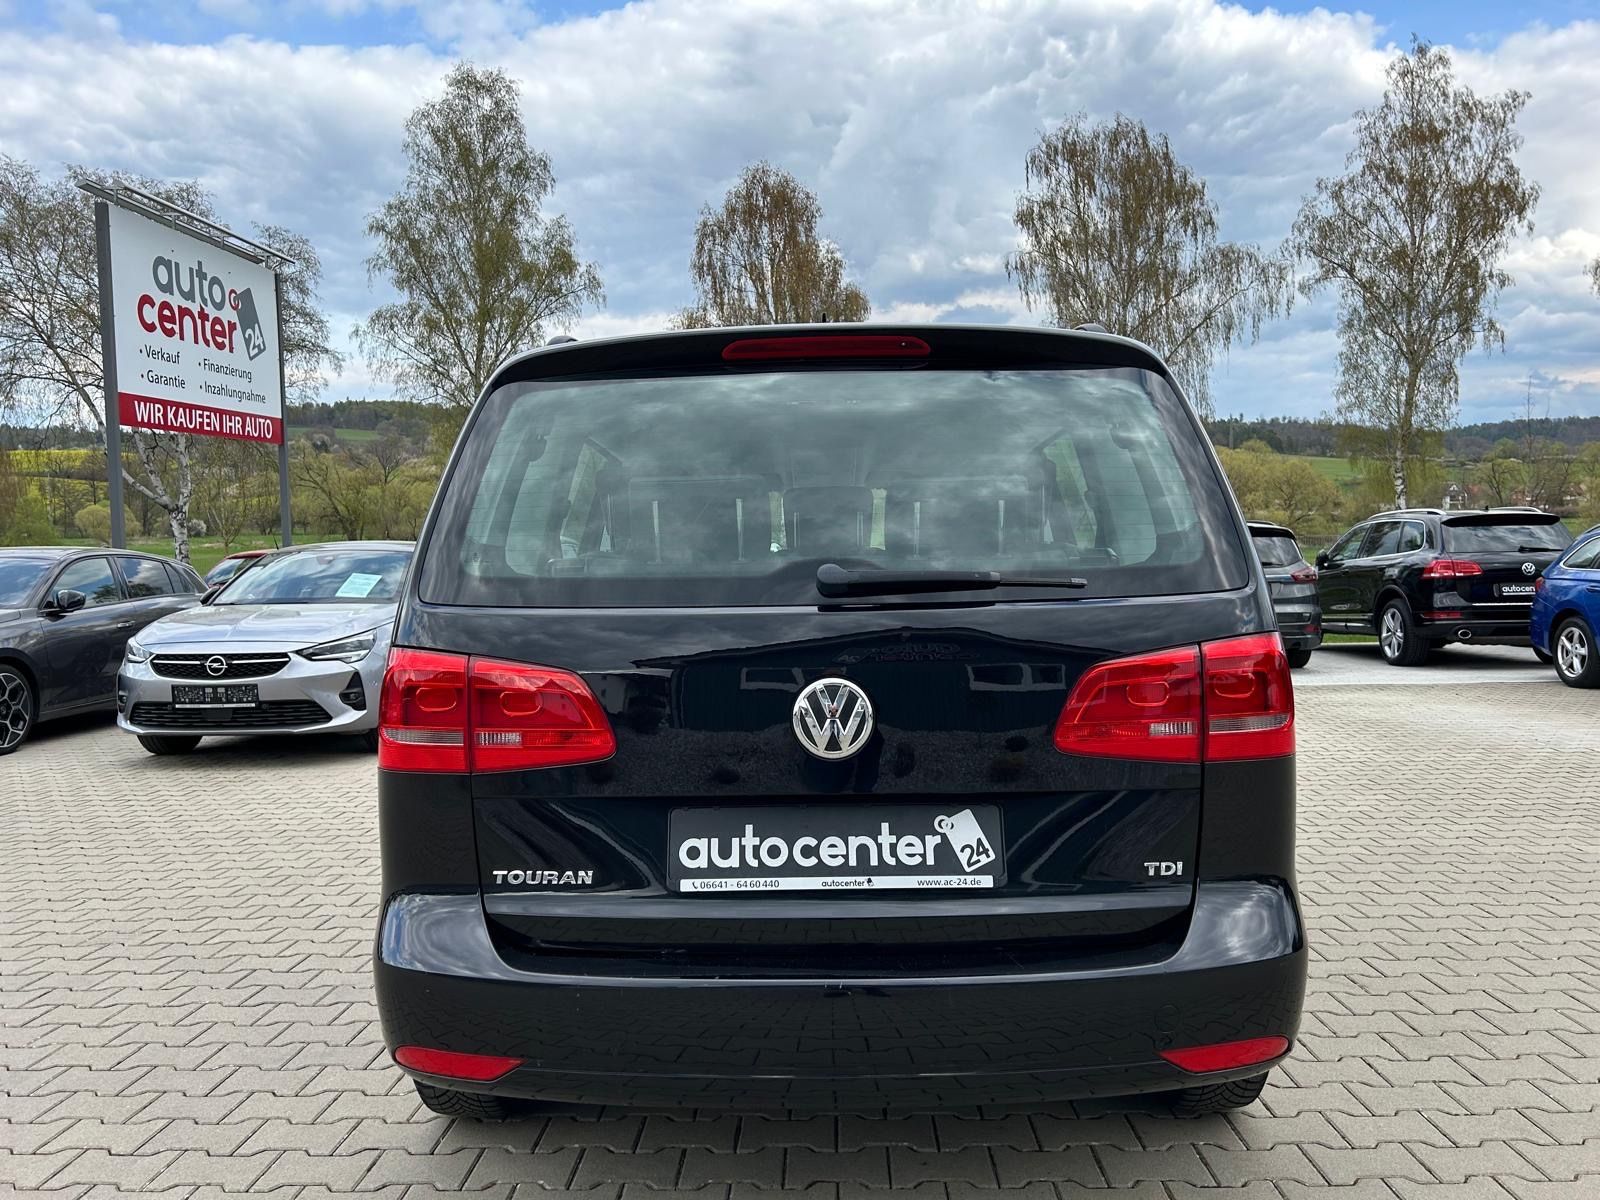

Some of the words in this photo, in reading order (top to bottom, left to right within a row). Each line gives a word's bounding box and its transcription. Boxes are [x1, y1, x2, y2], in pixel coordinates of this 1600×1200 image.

[152, 255, 226, 311] auto
[137, 293, 237, 353] center
[245, 323, 265, 357] 24
[145, 344, 180, 364] Verkauf
[146, 369, 186, 389] Garantie
[203, 358, 252, 383] Finanzierung
[204, 381, 266, 404] Inzahlungnahme
[134, 400, 164, 425] WIR
[167, 406, 220, 432] KAUFEN
[222, 414, 243, 436] IHR
[245, 416, 273, 439] AUTO
[959, 837, 993, 867] 24
[492, 869, 594, 885] TOURAN
[1143, 861, 1183, 876] TDI
[699, 881, 728, 890] 06641
[821, 879, 865, 887] autocenter
[917, 877, 982, 886] www.ac-24.de
